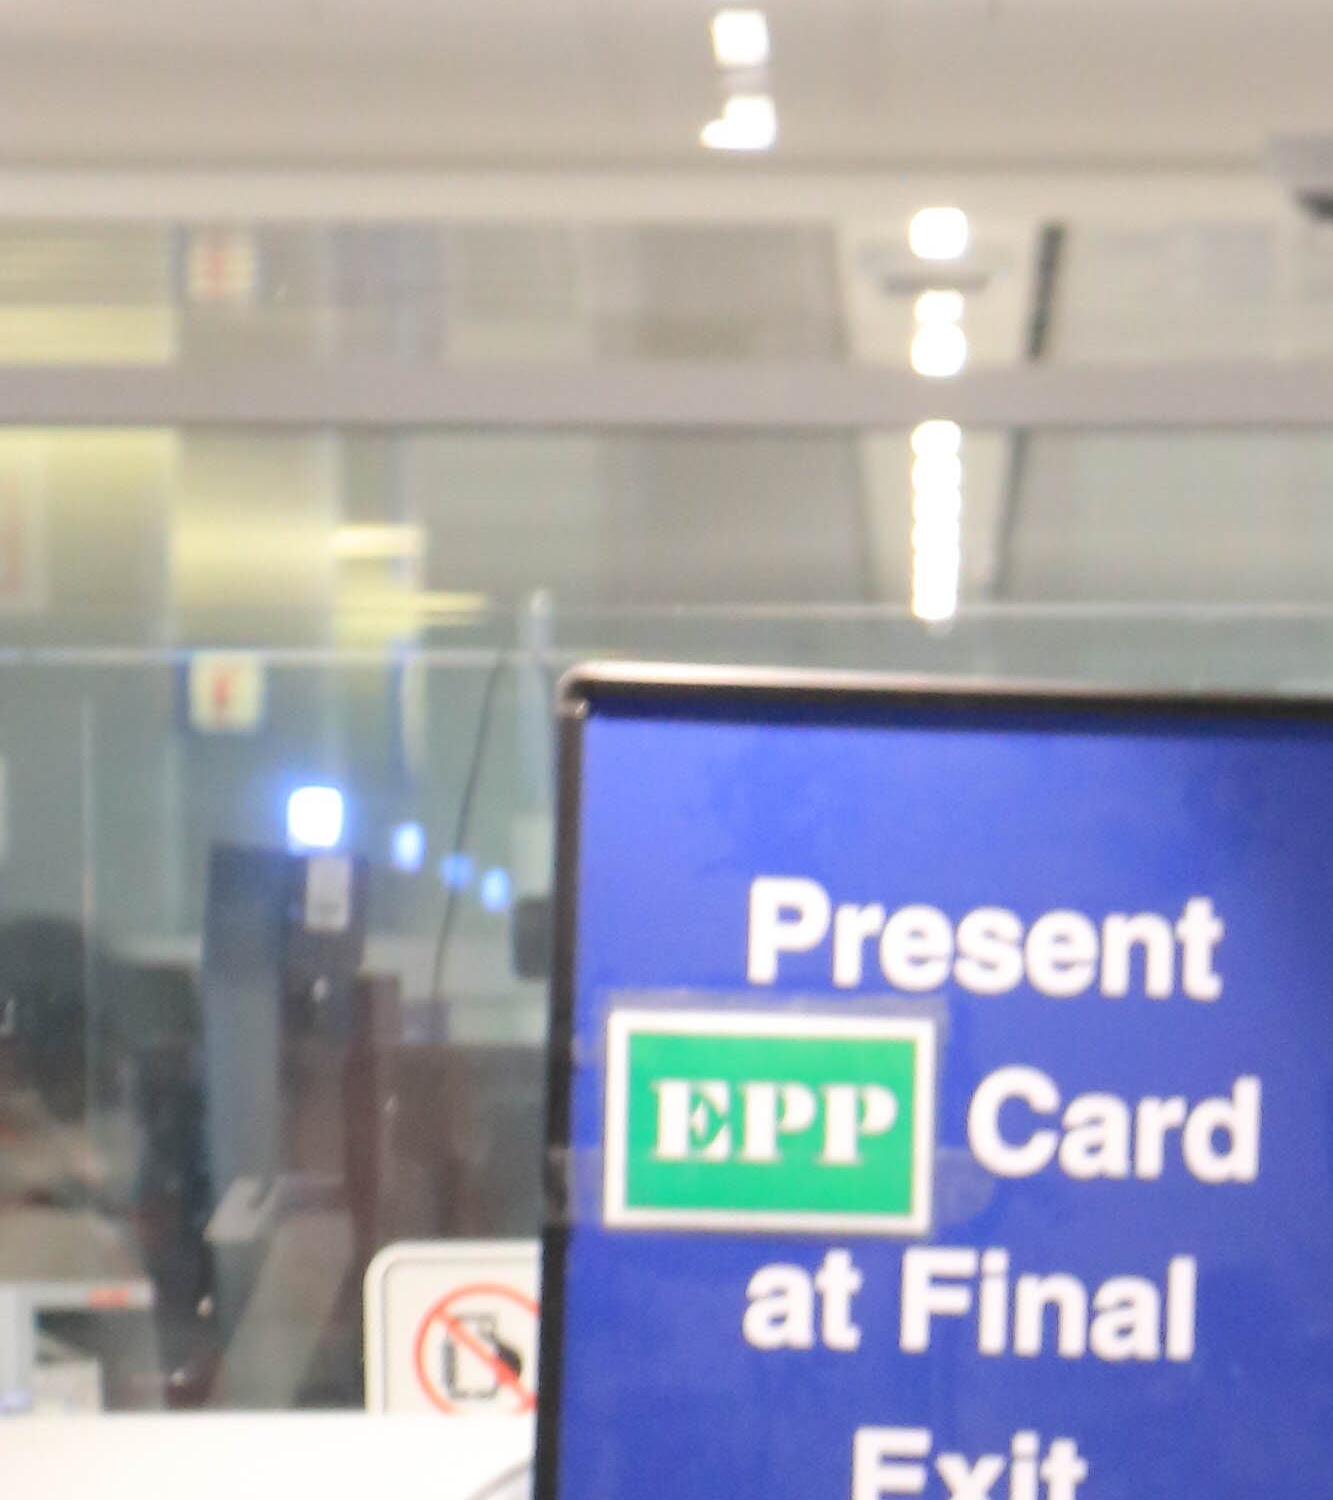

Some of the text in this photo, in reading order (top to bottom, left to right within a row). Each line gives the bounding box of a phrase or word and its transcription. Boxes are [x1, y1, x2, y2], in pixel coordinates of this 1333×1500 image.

[746, 874, 1225, 1001] Present
[650, 1064, 1263, 1184] EPP Card
[741, 1247, 1198, 1363] at Final
